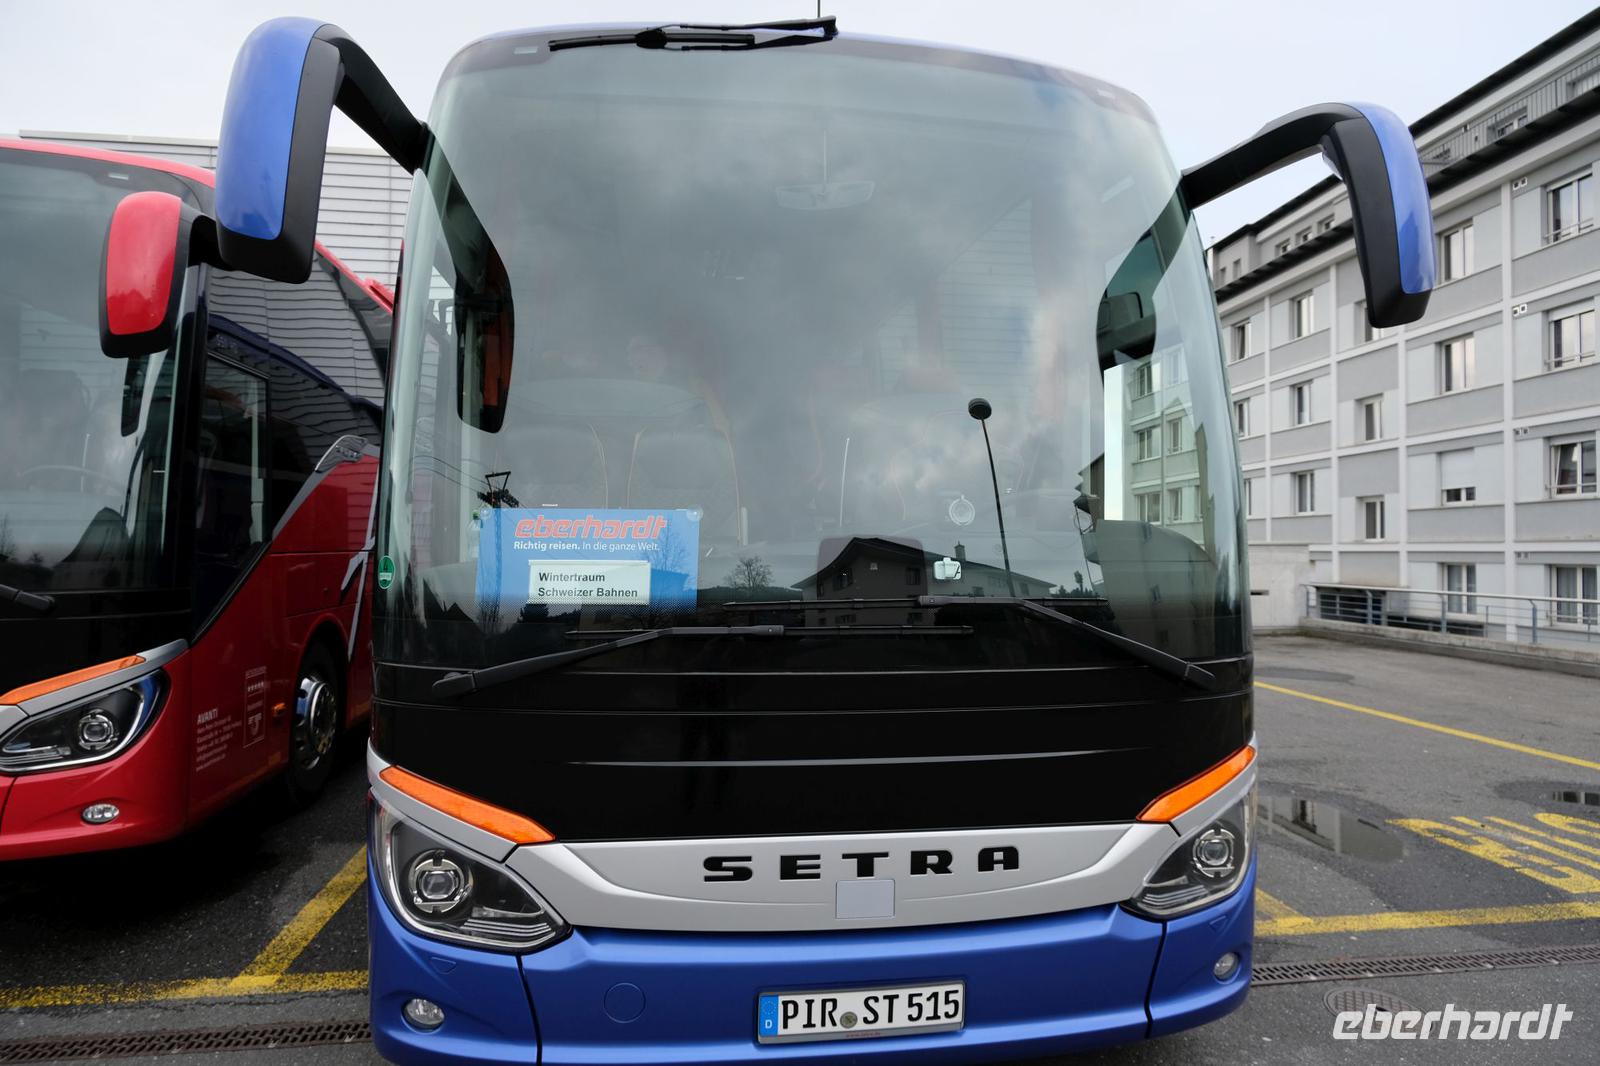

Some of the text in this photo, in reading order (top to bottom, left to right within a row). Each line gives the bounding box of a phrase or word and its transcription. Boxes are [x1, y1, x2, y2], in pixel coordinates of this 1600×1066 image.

[514, 515, 668, 539] eberhardt
[513, 541, 547, 551] Richtig
[549, 541, 580, 550] reisen.
[592, 541, 608, 550] die
[608, 543, 637, 552] ganze
[637, 542, 660, 550] Welt.
[538, 572, 606, 582] Wintertraum
[537, 587, 638, 597] Schweizer Bahnen
[703, 846, 1020, 882] SETRA
[781, 989, 960, 1029] PIR ST 515
[764, 1019, 773, 1029] D
